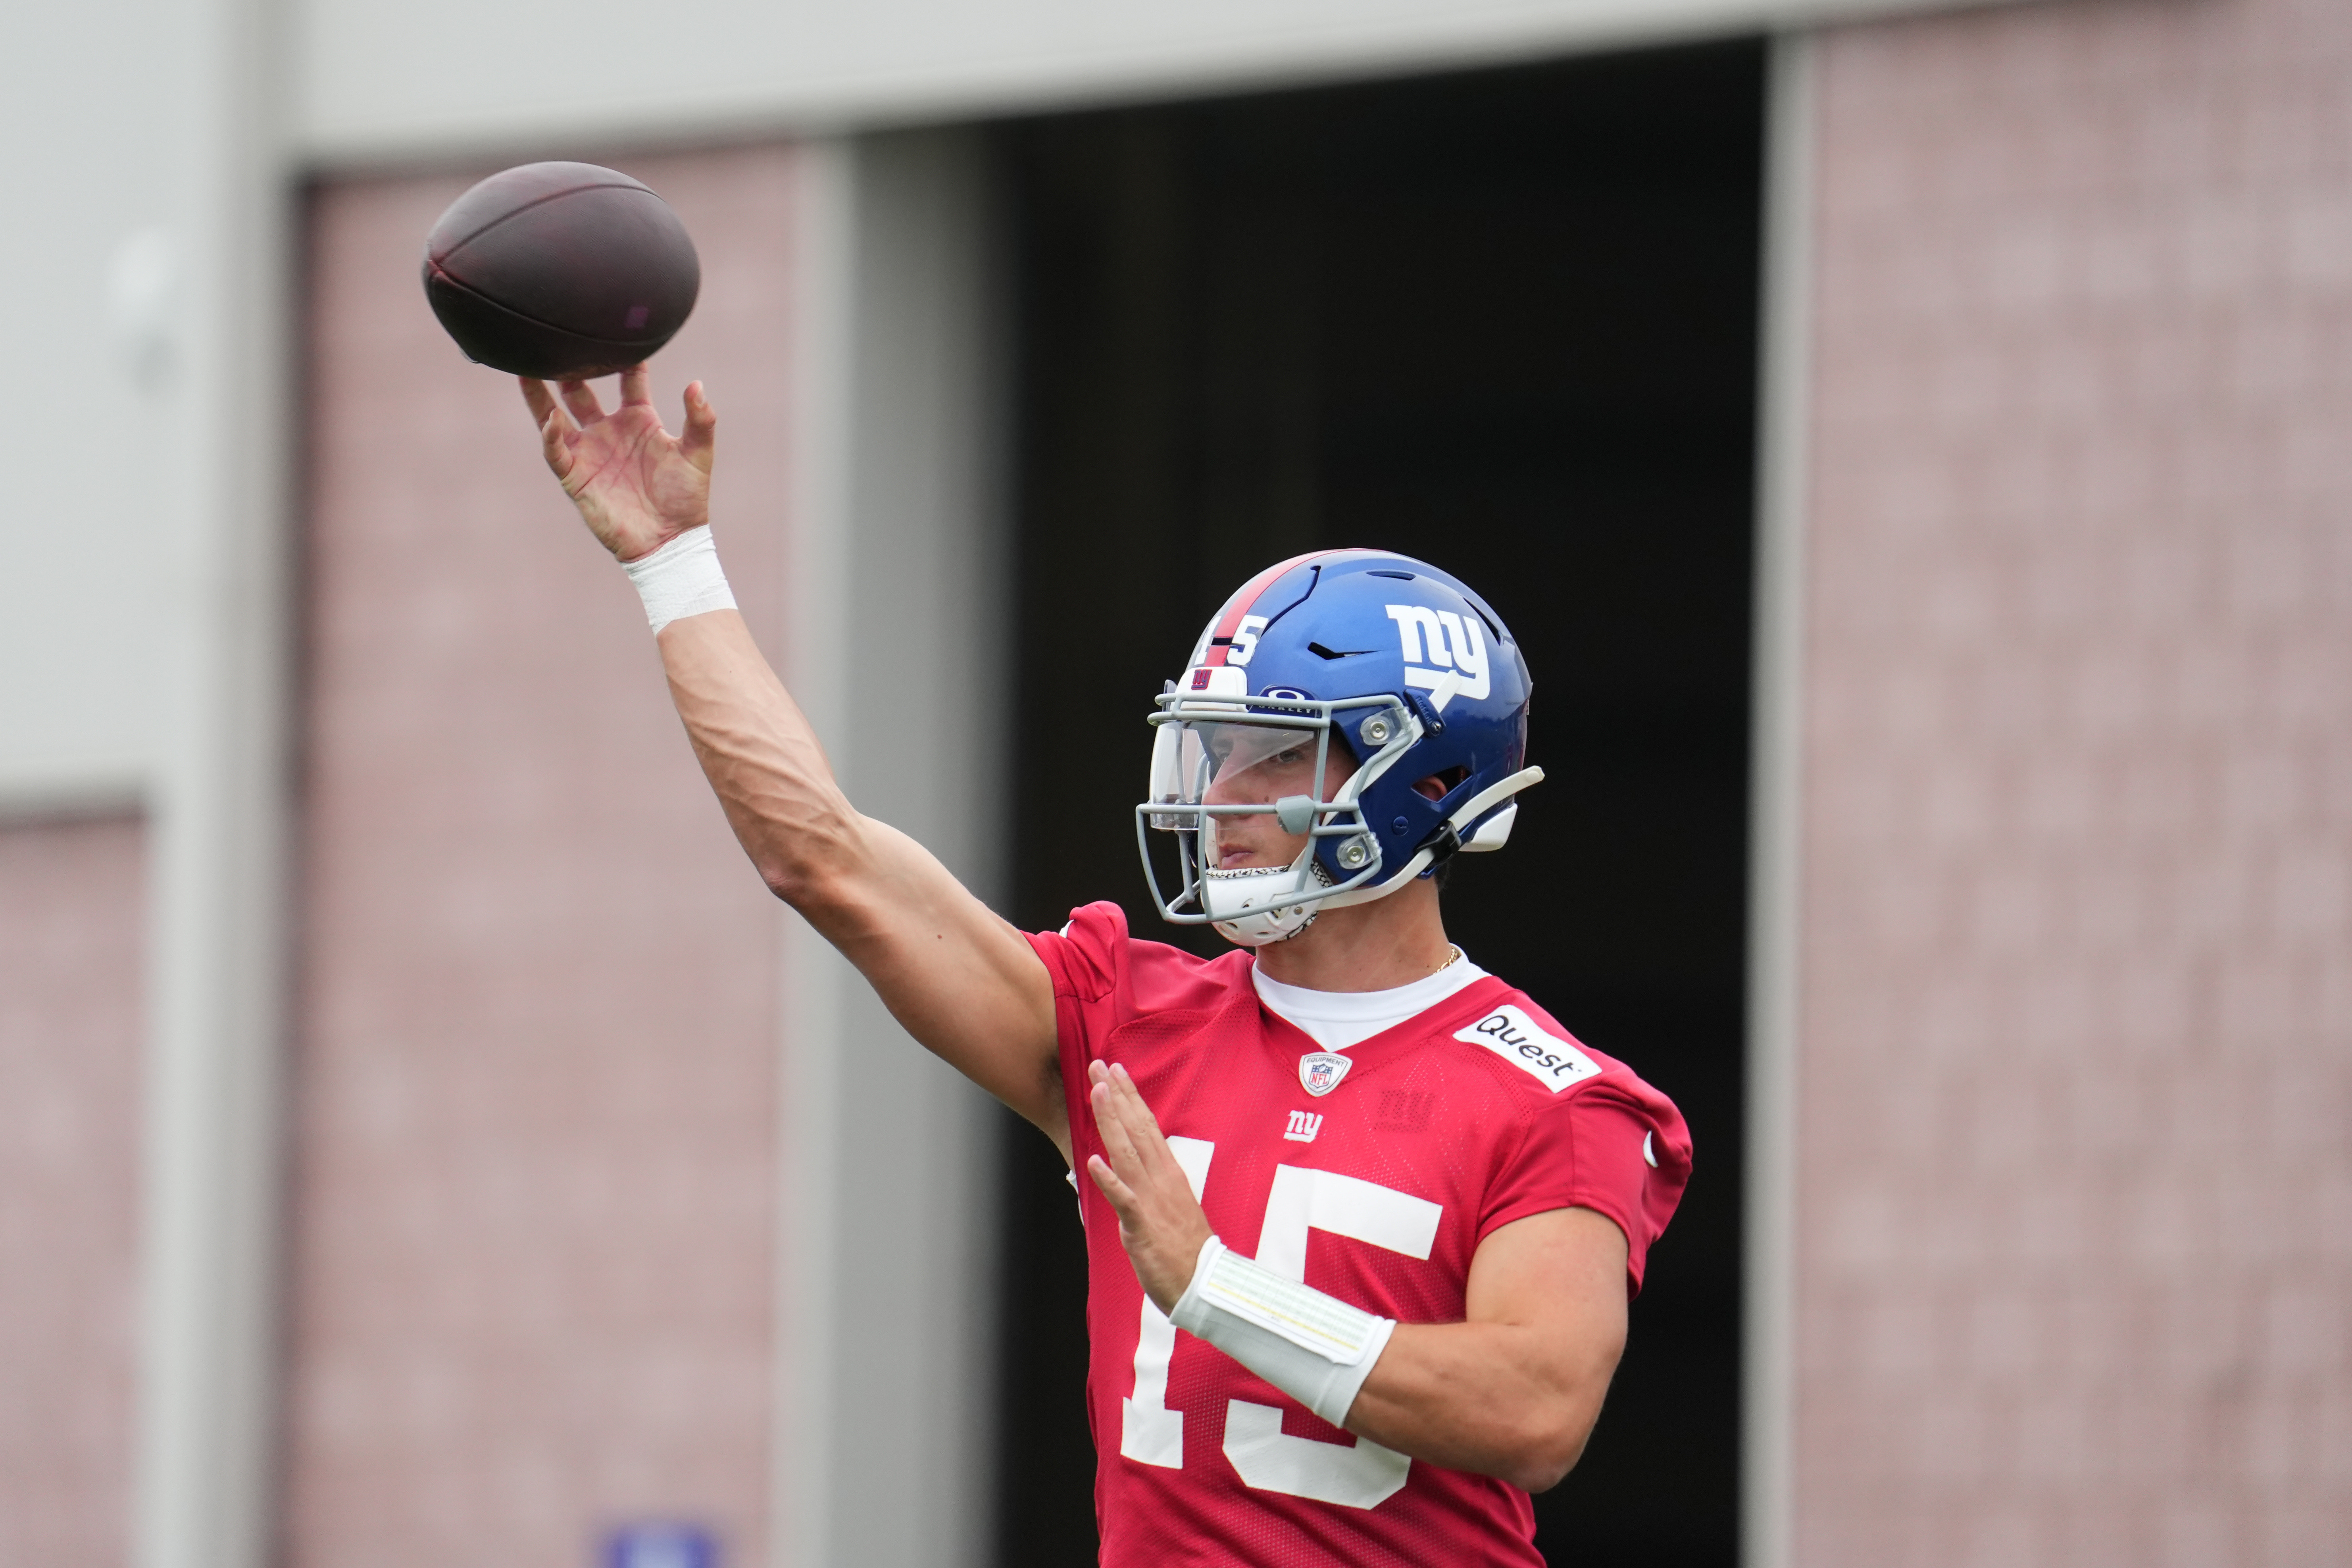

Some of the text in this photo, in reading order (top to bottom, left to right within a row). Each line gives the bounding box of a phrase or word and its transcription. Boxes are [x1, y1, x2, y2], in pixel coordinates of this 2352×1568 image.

[1194, 615, 1269, 666] 15
[1306, 1057, 1344, 1067] EQUIPMENT
[1476, 1014, 1574, 1077] Quest
[1310, 1073, 1328, 1085] NFL
[1120, 1135, 1443, 1510] 15
